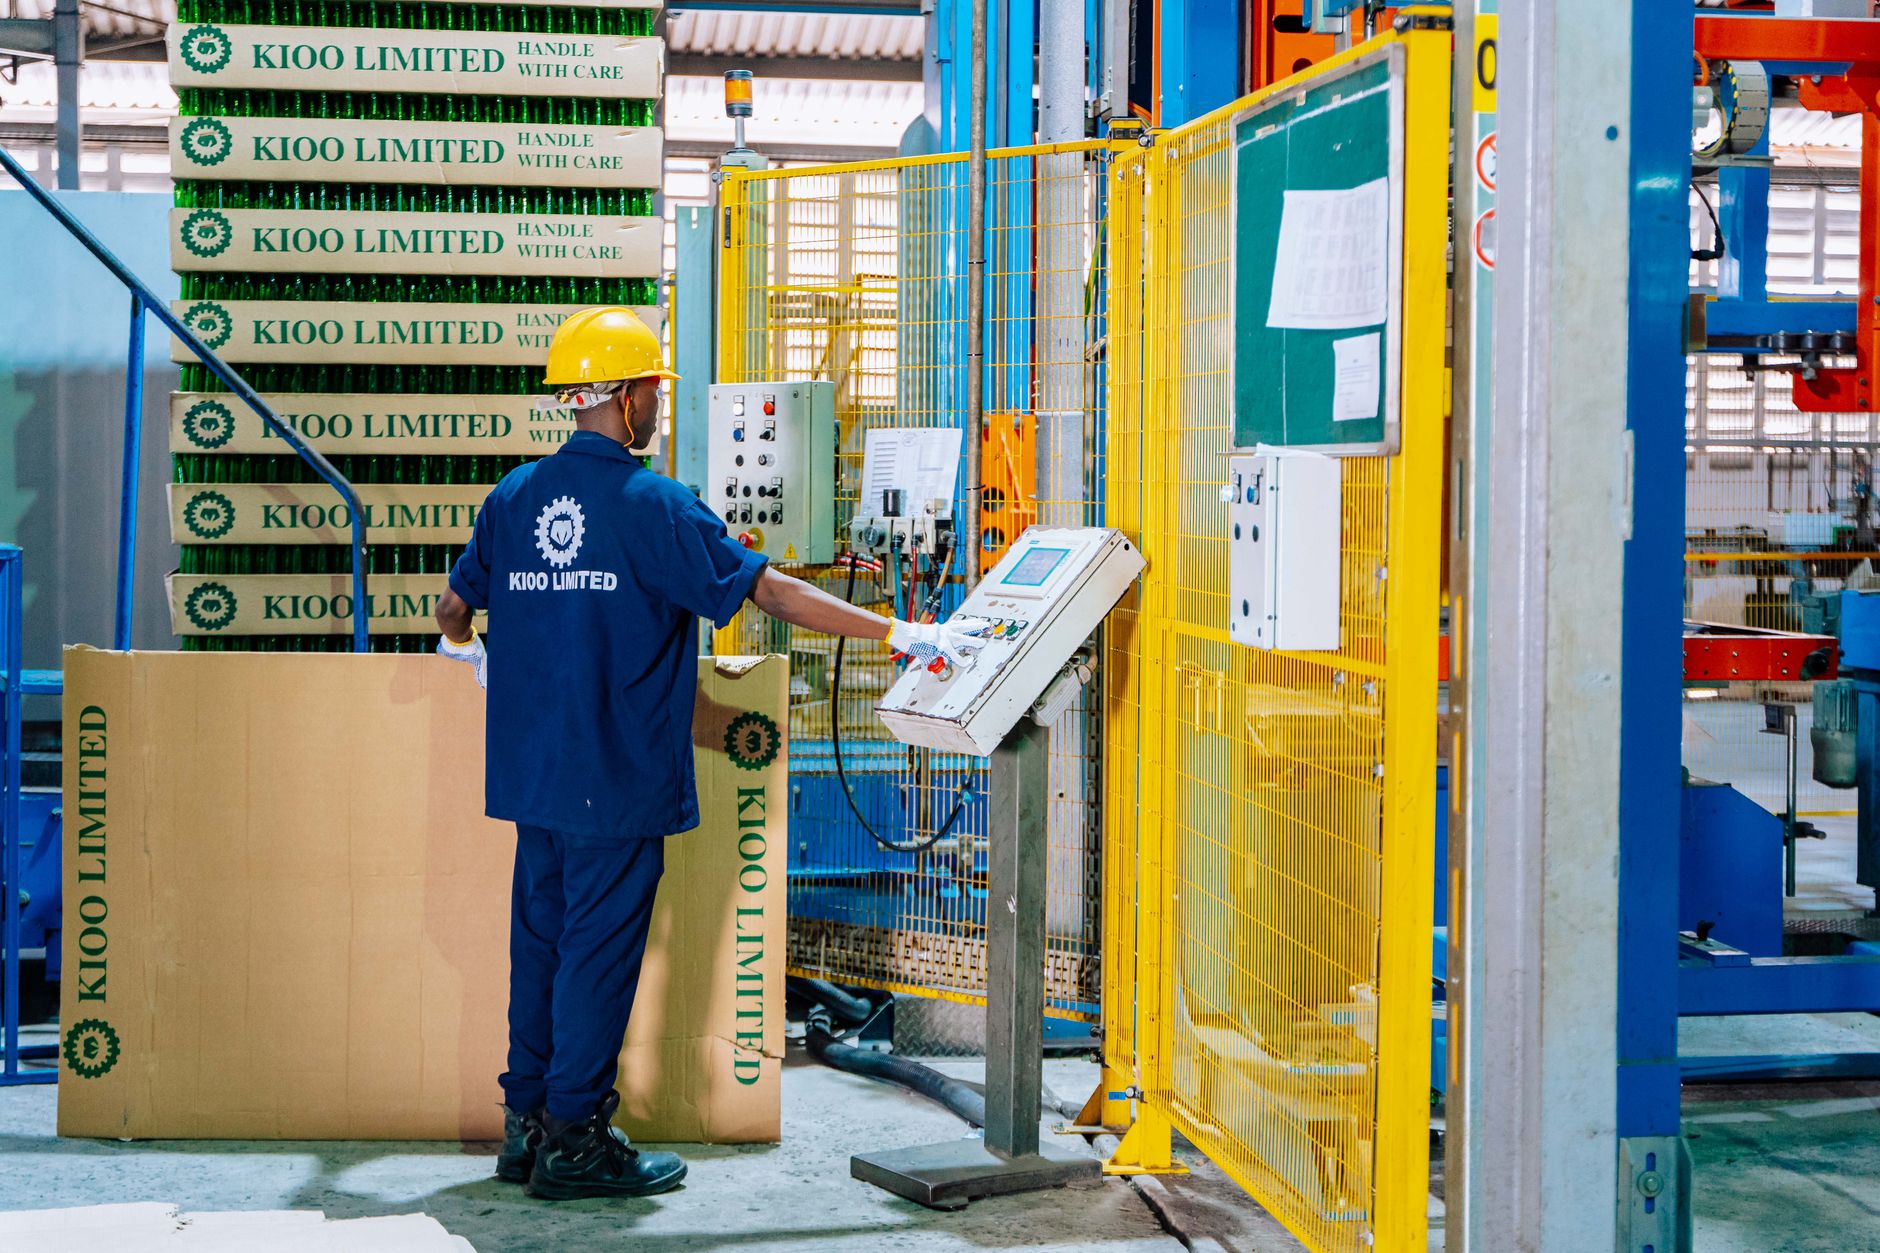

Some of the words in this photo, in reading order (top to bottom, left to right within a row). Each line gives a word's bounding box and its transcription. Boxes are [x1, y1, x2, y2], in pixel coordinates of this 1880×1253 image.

[253, 43, 344, 70] KIOO
[354, 45, 505, 74] LIMITED
[517, 41, 594, 58] HANDLE
[517, 63, 567, 79] WITH
[573, 65, 624, 80] CARE
[253, 136, 344, 161] KIOO
[355, 137, 505, 165] LIMITED
[517, 132, 594, 148] HANDLE
[517, 154, 567, 169] WITH
[573, 155, 624, 171] CARE
[253, 227, 344, 253] KIOO
[354, 228, 504, 255] LIMITED
[517, 222, 594, 238] HANDLE
[517, 243, 567, 259] WITH
[573, 245, 623, 260] CARE
[517, 313, 568, 326] HAND
[253, 319, 344, 345] KIOO
[354, 319, 504, 346] LIMITED
[517, 334, 554, 348] WIT
[362, 413, 512, 439] LIMITED
[529, 408, 576, 421] HAN
[262, 503, 352, 528] KIOO
[365, 504, 482, 528] LIMITE
[509, 571, 549, 591] KIOO
[552, 570, 618, 591] LIMITED
[263, 594, 353, 619] KIOO
[78, 705, 107, 883] LIMITED
[737, 785, 768, 893] KIOO
[78, 896, 108, 1003] KIOO
[733, 906, 764, 1086] LIMITED
